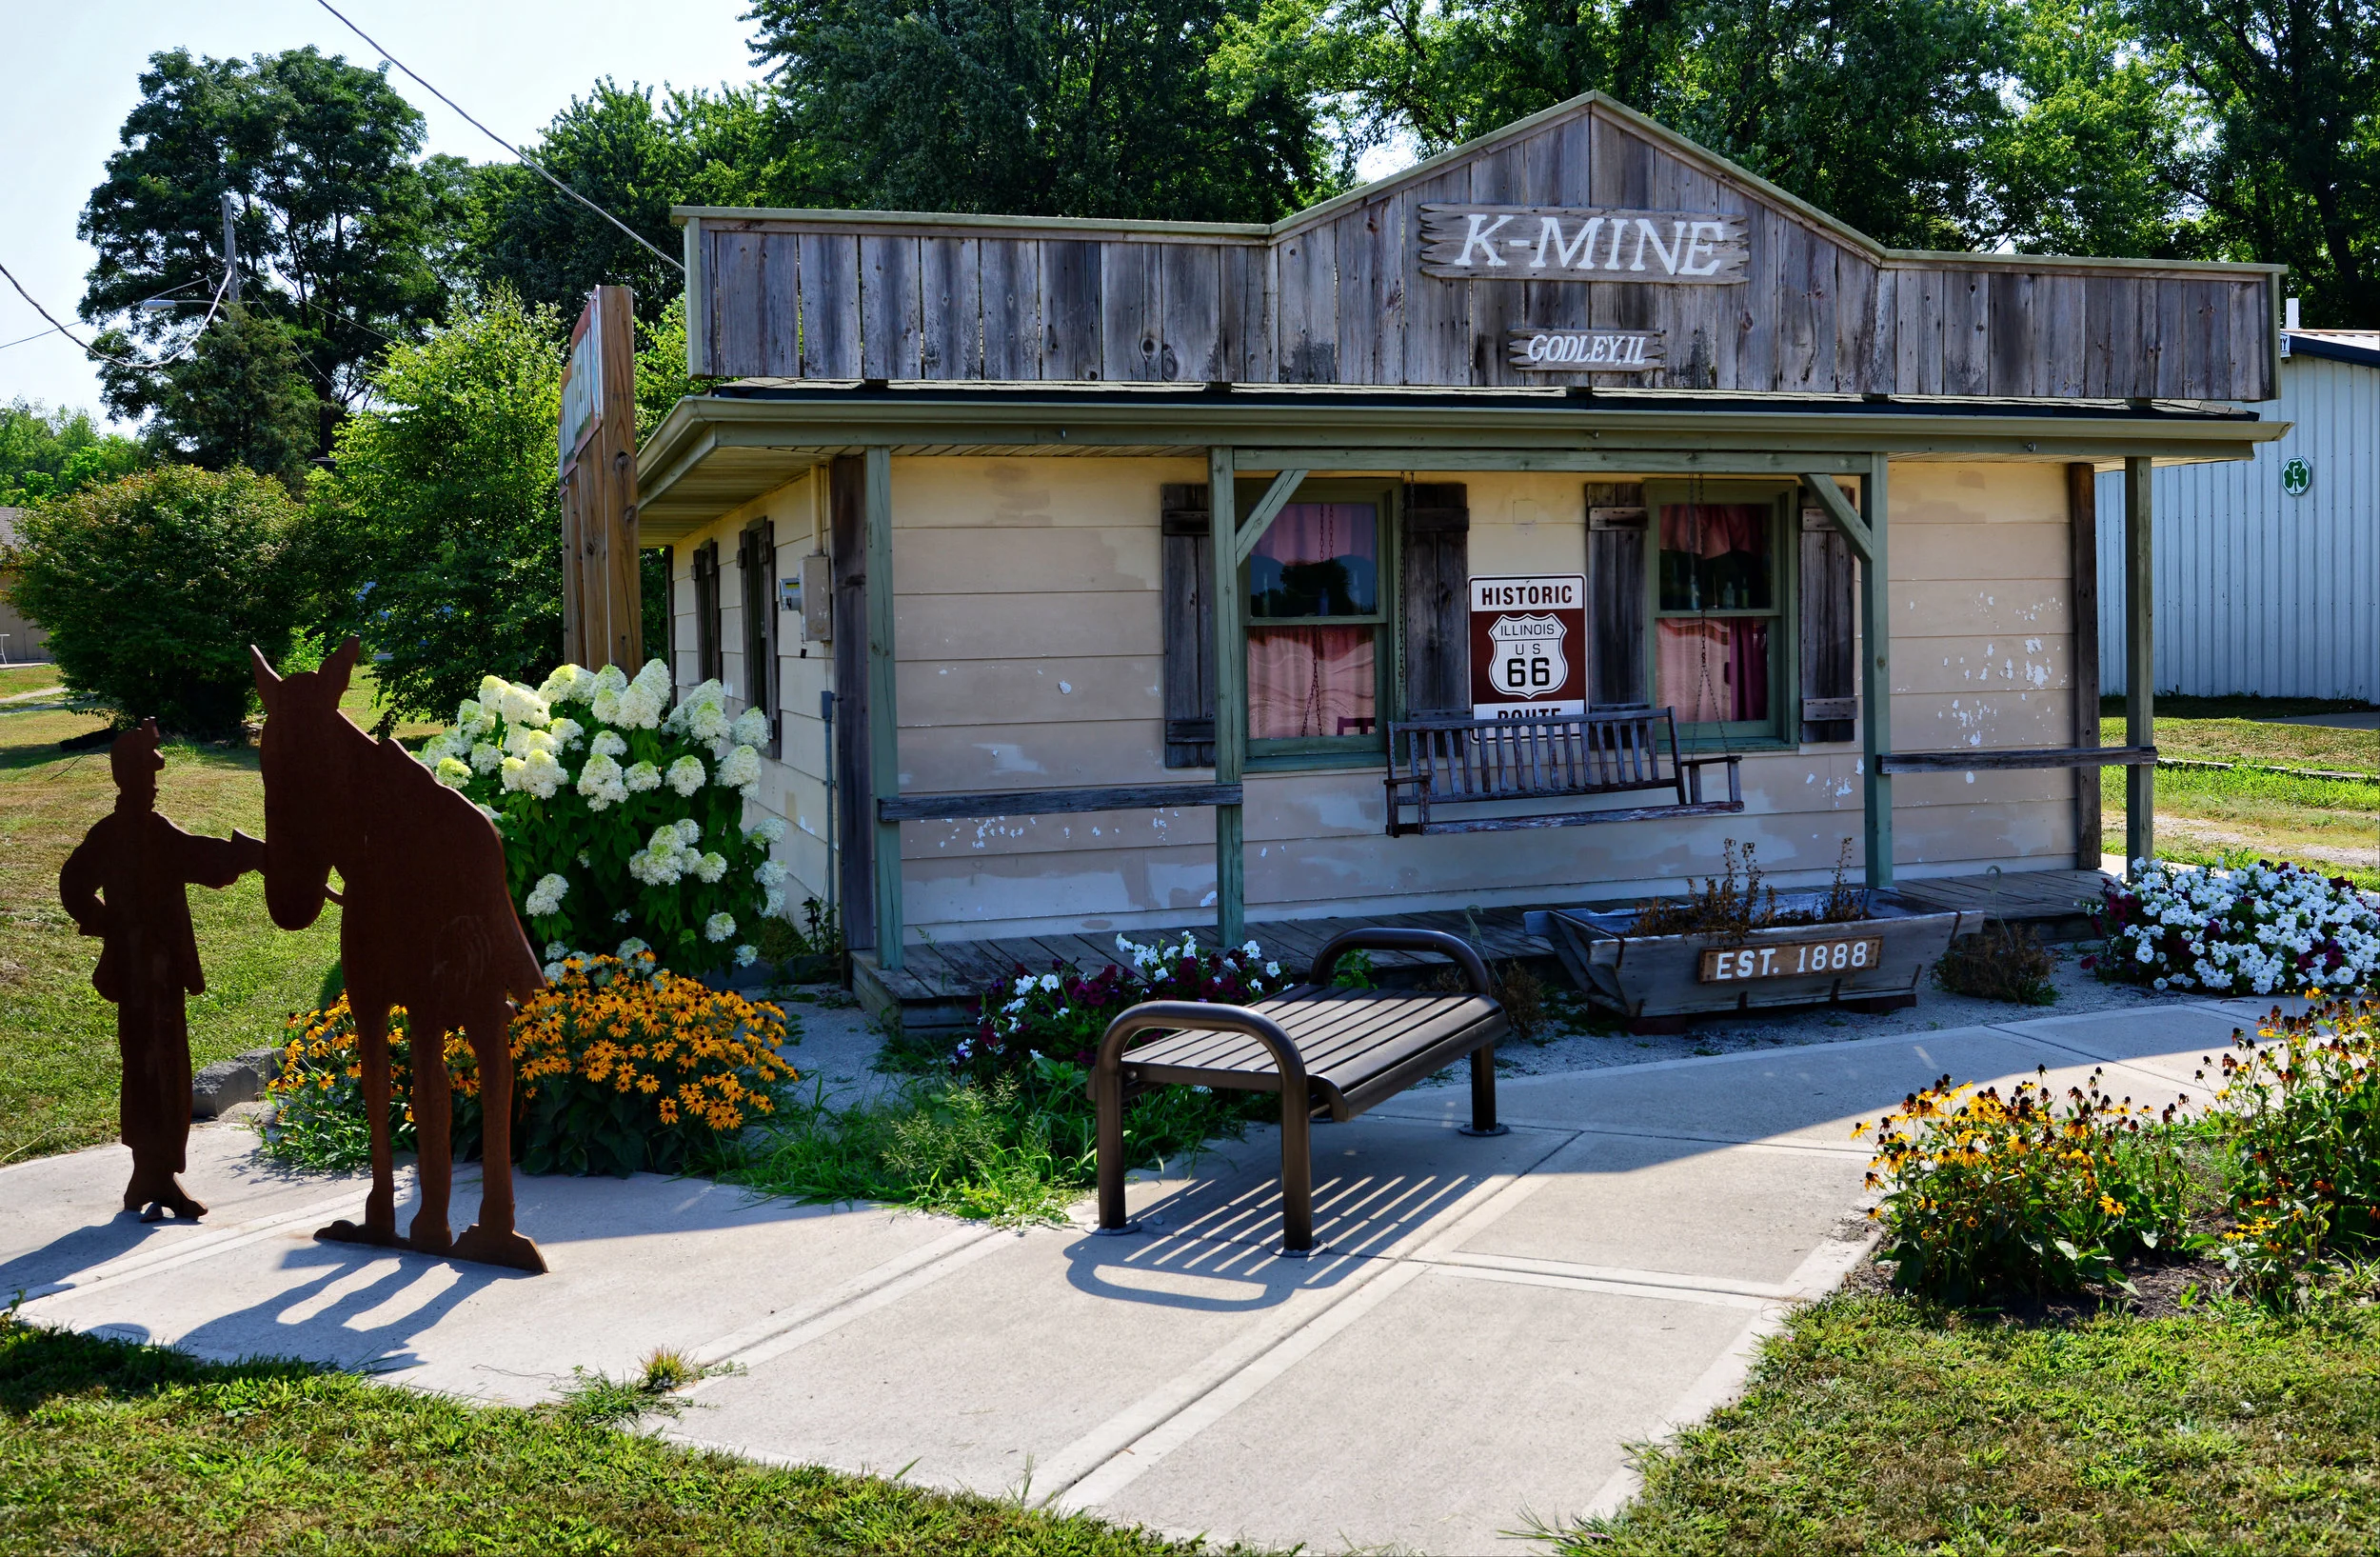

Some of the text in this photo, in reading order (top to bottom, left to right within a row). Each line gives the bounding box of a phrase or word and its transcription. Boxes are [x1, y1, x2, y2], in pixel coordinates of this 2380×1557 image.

[1454, 214, 1724, 276] K-MINE
[1481, 586, 1573, 606] HISTORIC
[1500, 624, 1555, 636] ILLINOIS
[1507, 657, 1550, 687] 66
[1716, 941, 1868, 980] EST. 1888
